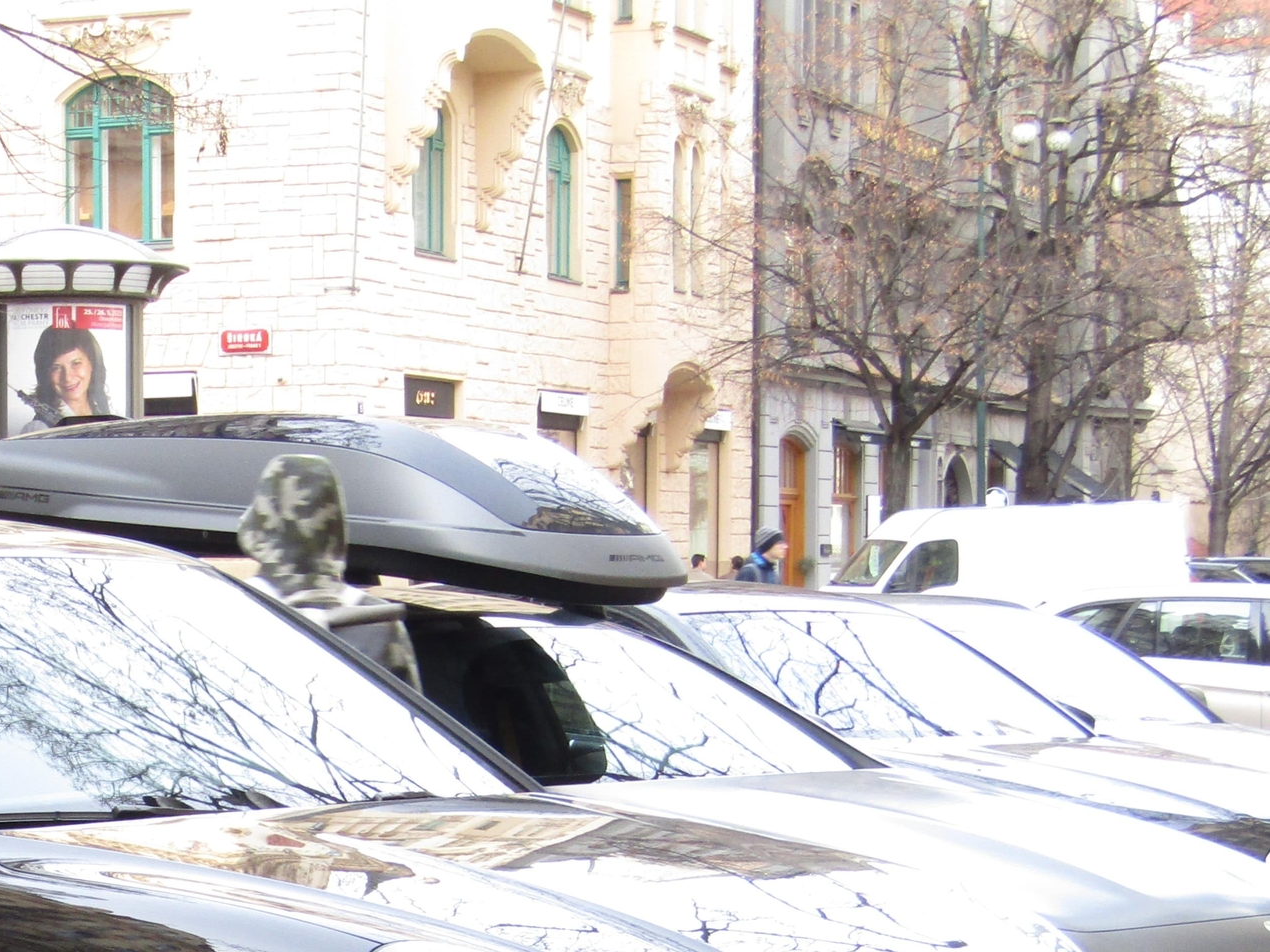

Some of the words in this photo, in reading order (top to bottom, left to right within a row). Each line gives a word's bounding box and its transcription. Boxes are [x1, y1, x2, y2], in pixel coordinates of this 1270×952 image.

[54, 307, 70, 328] fok
[227, 331, 263, 343] ŠIROKÁ
[14, 491, 50, 503] AMG
